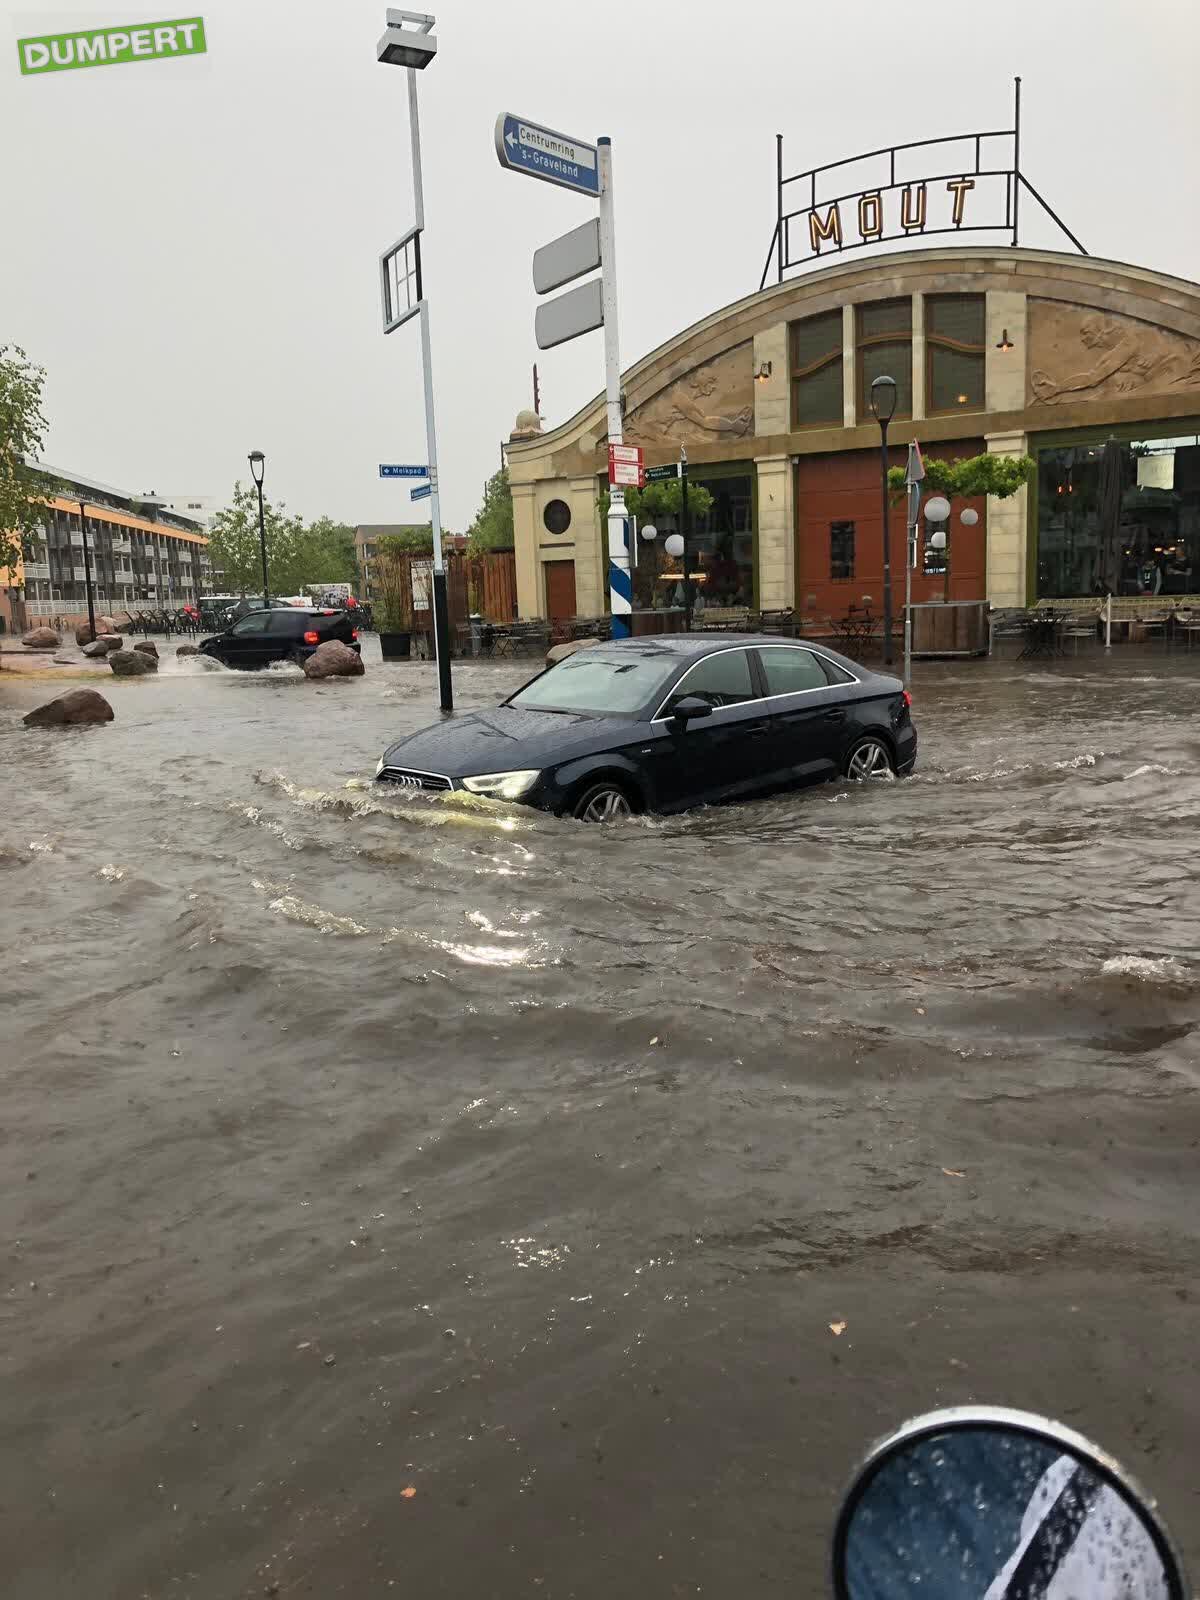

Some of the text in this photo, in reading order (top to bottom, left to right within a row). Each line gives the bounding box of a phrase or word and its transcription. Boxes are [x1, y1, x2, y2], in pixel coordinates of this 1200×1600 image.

[520, 127, 575, 160] Centrumring
[518, 144, 579, 177] 's-Graveland
[808, 179, 976, 252] MOUT
[392, 467, 422, 475] Melkpad
